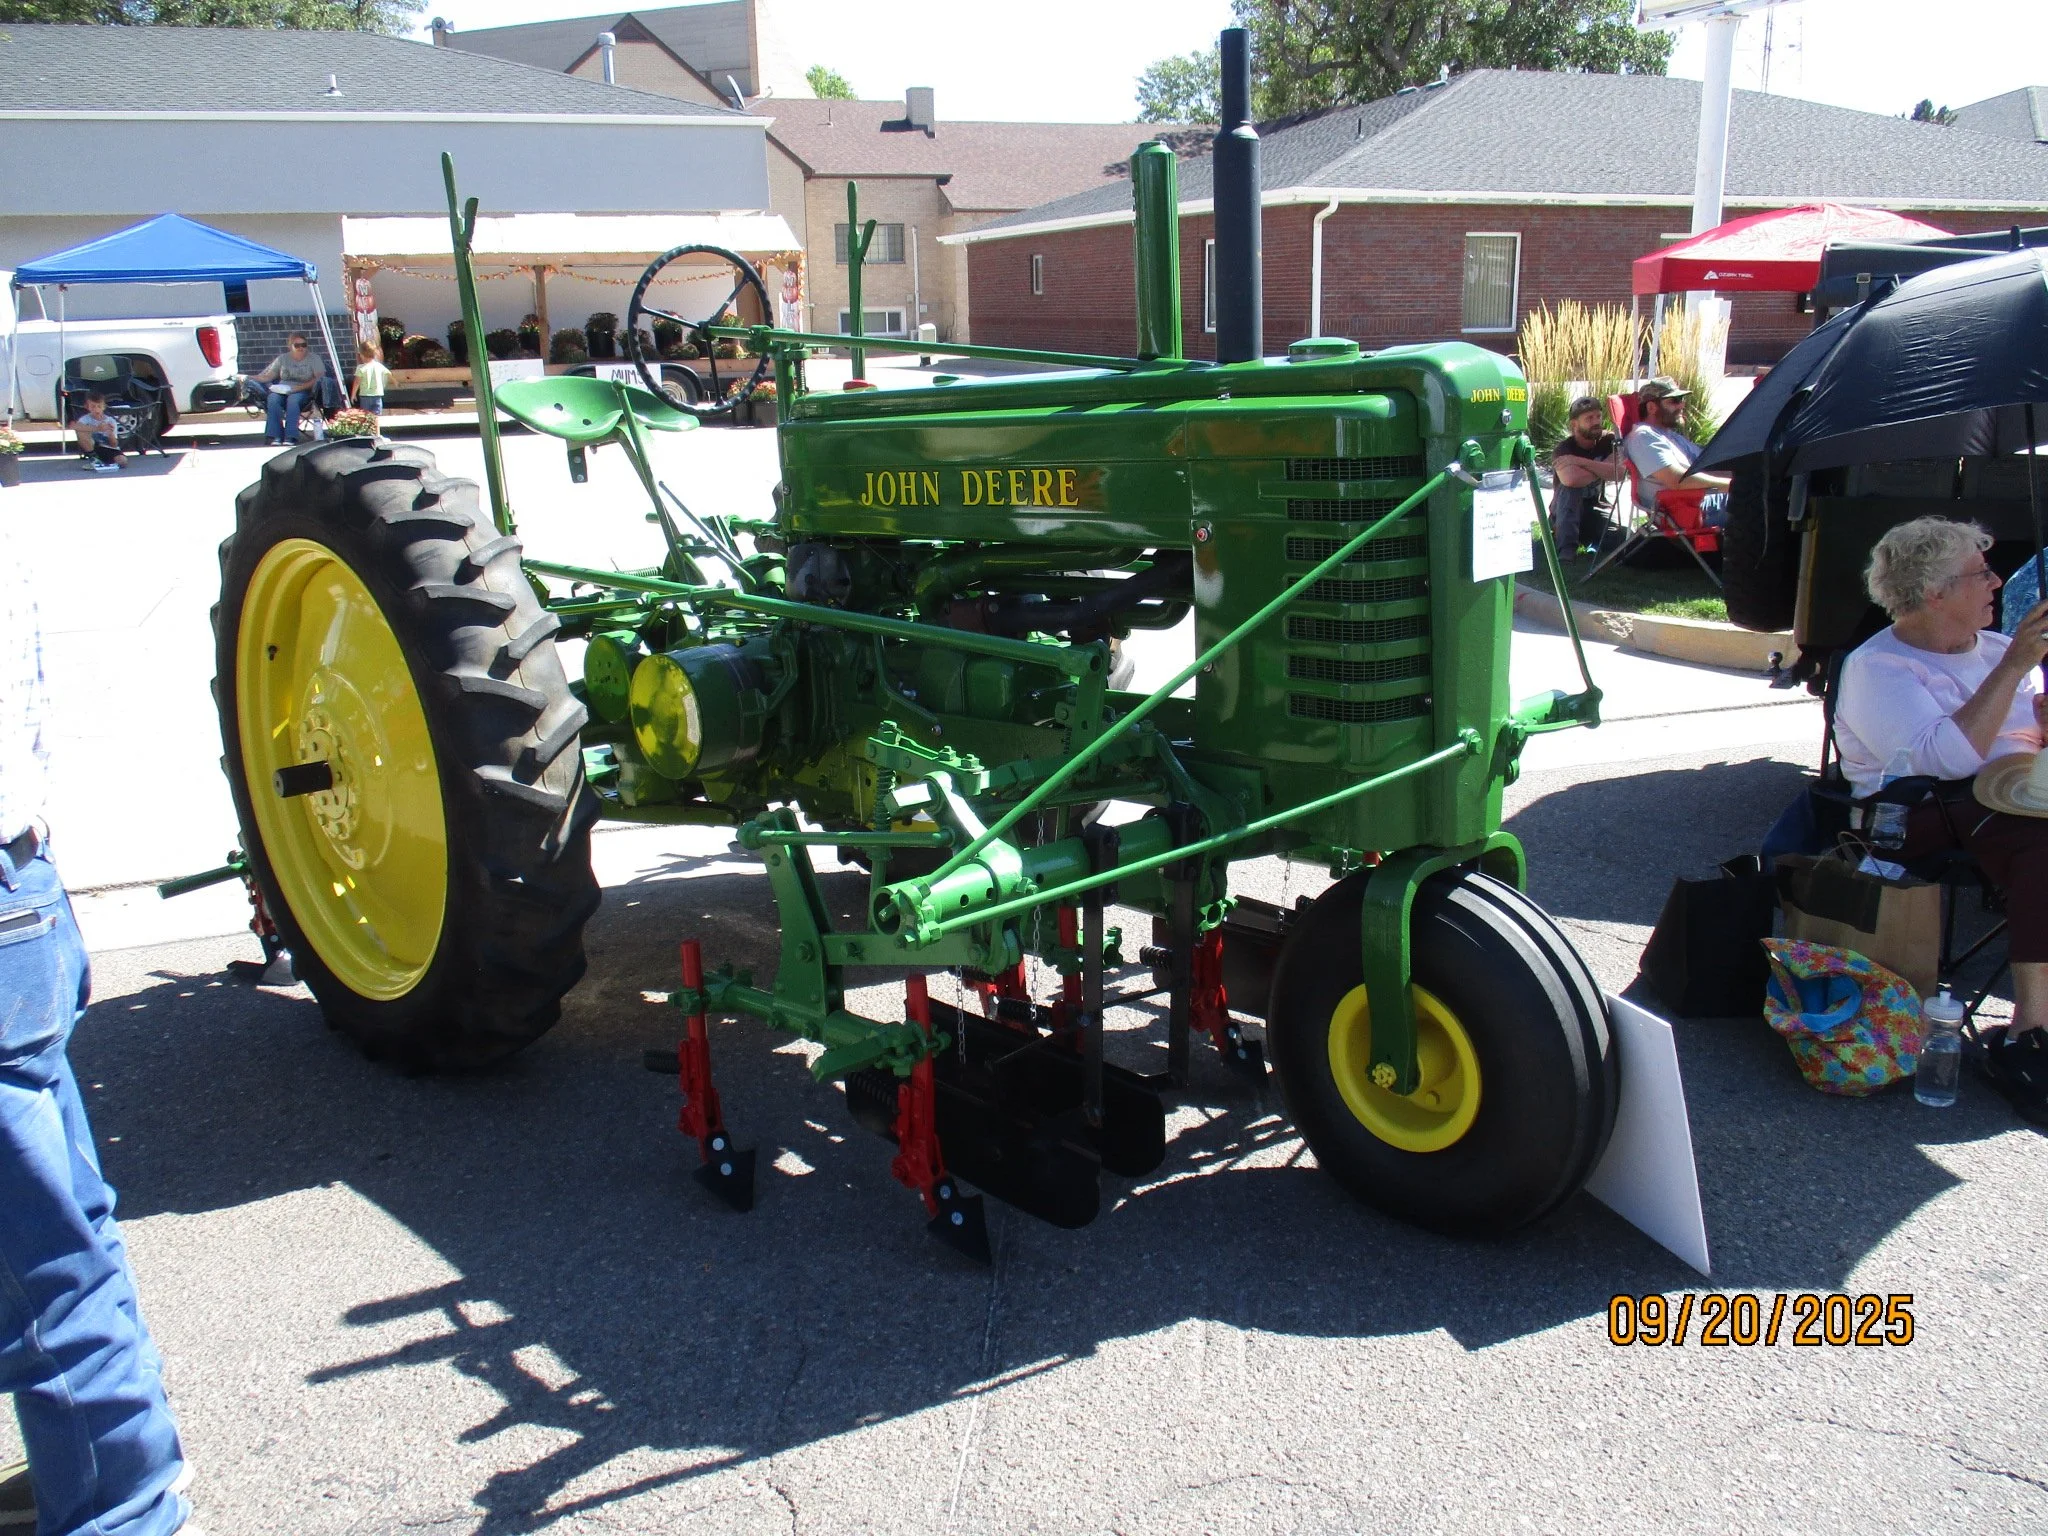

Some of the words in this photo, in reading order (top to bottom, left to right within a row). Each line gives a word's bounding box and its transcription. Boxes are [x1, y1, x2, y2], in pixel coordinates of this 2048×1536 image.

[1470, 387, 1500, 403] JOHN
[1506, 387, 1526, 402] DEERE
[861, 470, 940, 506] JOHN
[960, 468, 1080, 507] DEERE
